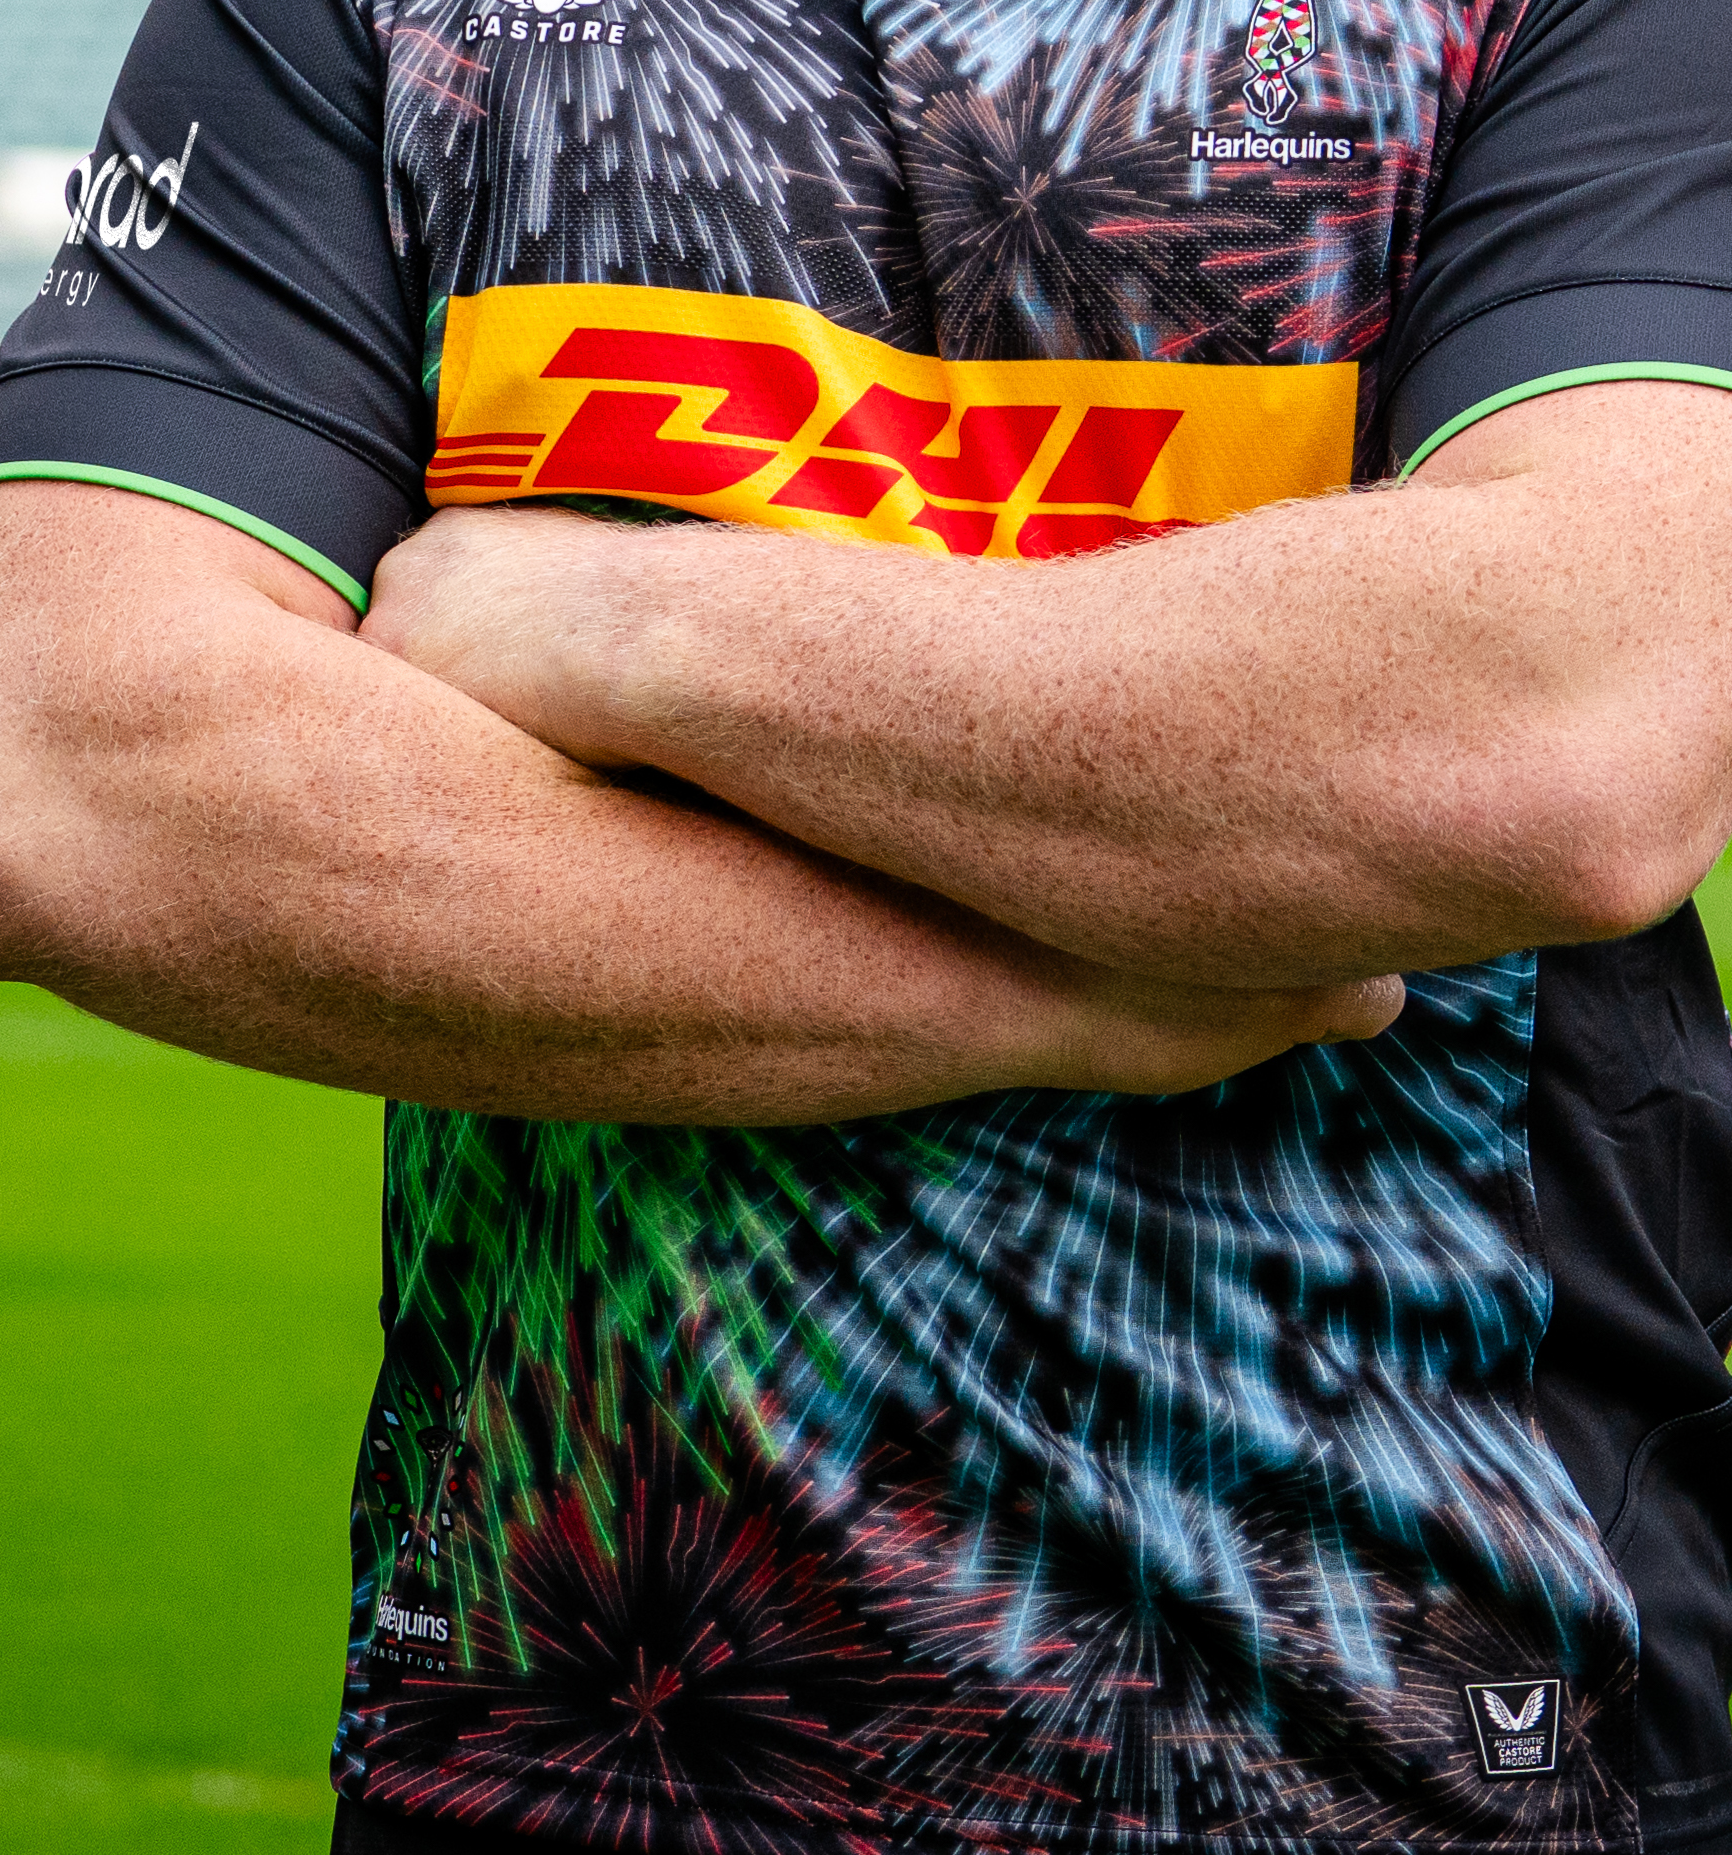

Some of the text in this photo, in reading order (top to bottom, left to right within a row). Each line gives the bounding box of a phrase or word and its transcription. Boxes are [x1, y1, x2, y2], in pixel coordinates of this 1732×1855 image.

[464, 14, 627, 45] CASTORE
[1190, 131, 1351, 165] Harlequins
[40, 268, 100, 307] ergy
[537, 327, 1194, 561] DHL
[1493, 1736, 1545, 1747] AUTHENTIC
[1498, 1745, 1542, 1757] CASTORE
[1499, 1755, 1542, 1766] PRODUCT
